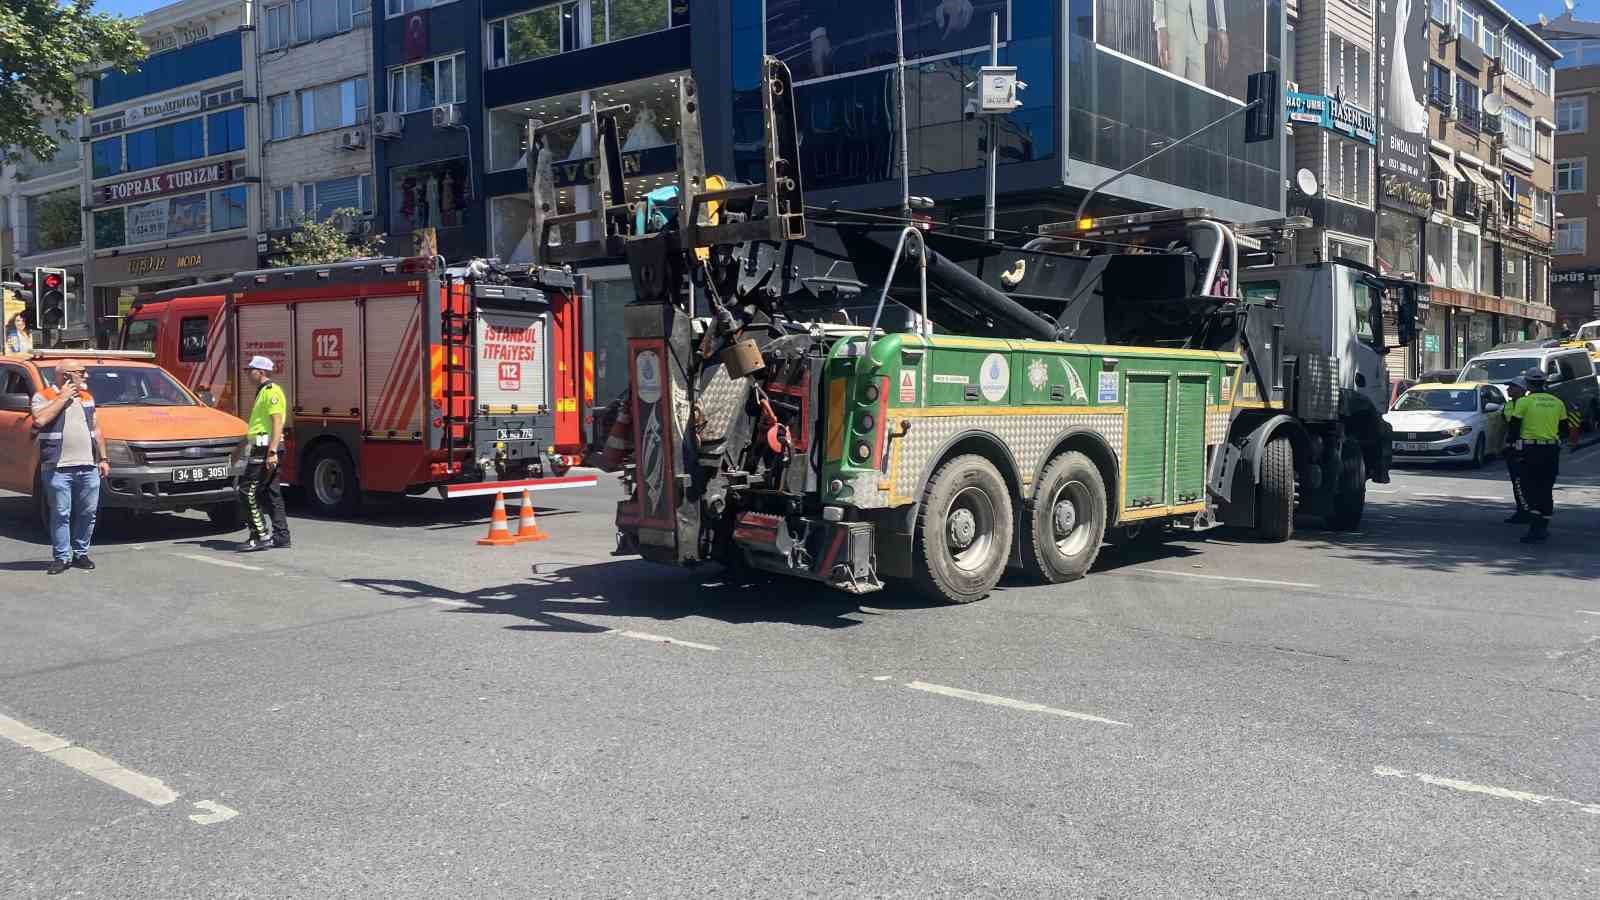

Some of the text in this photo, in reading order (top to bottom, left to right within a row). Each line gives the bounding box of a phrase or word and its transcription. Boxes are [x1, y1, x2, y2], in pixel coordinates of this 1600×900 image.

[110, 176, 162, 200] TOPRAK
[176, 255, 202, 268] MODA
[485, 326, 536, 343] İSTANBUL
[316, 334, 338, 357] 112
[483, 343, 535, 361] İTFAİYESİ
[501, 364, 518, 379] 112
[177, 470, 189, 480] 34
[207, 467, 226, 477] 3051
